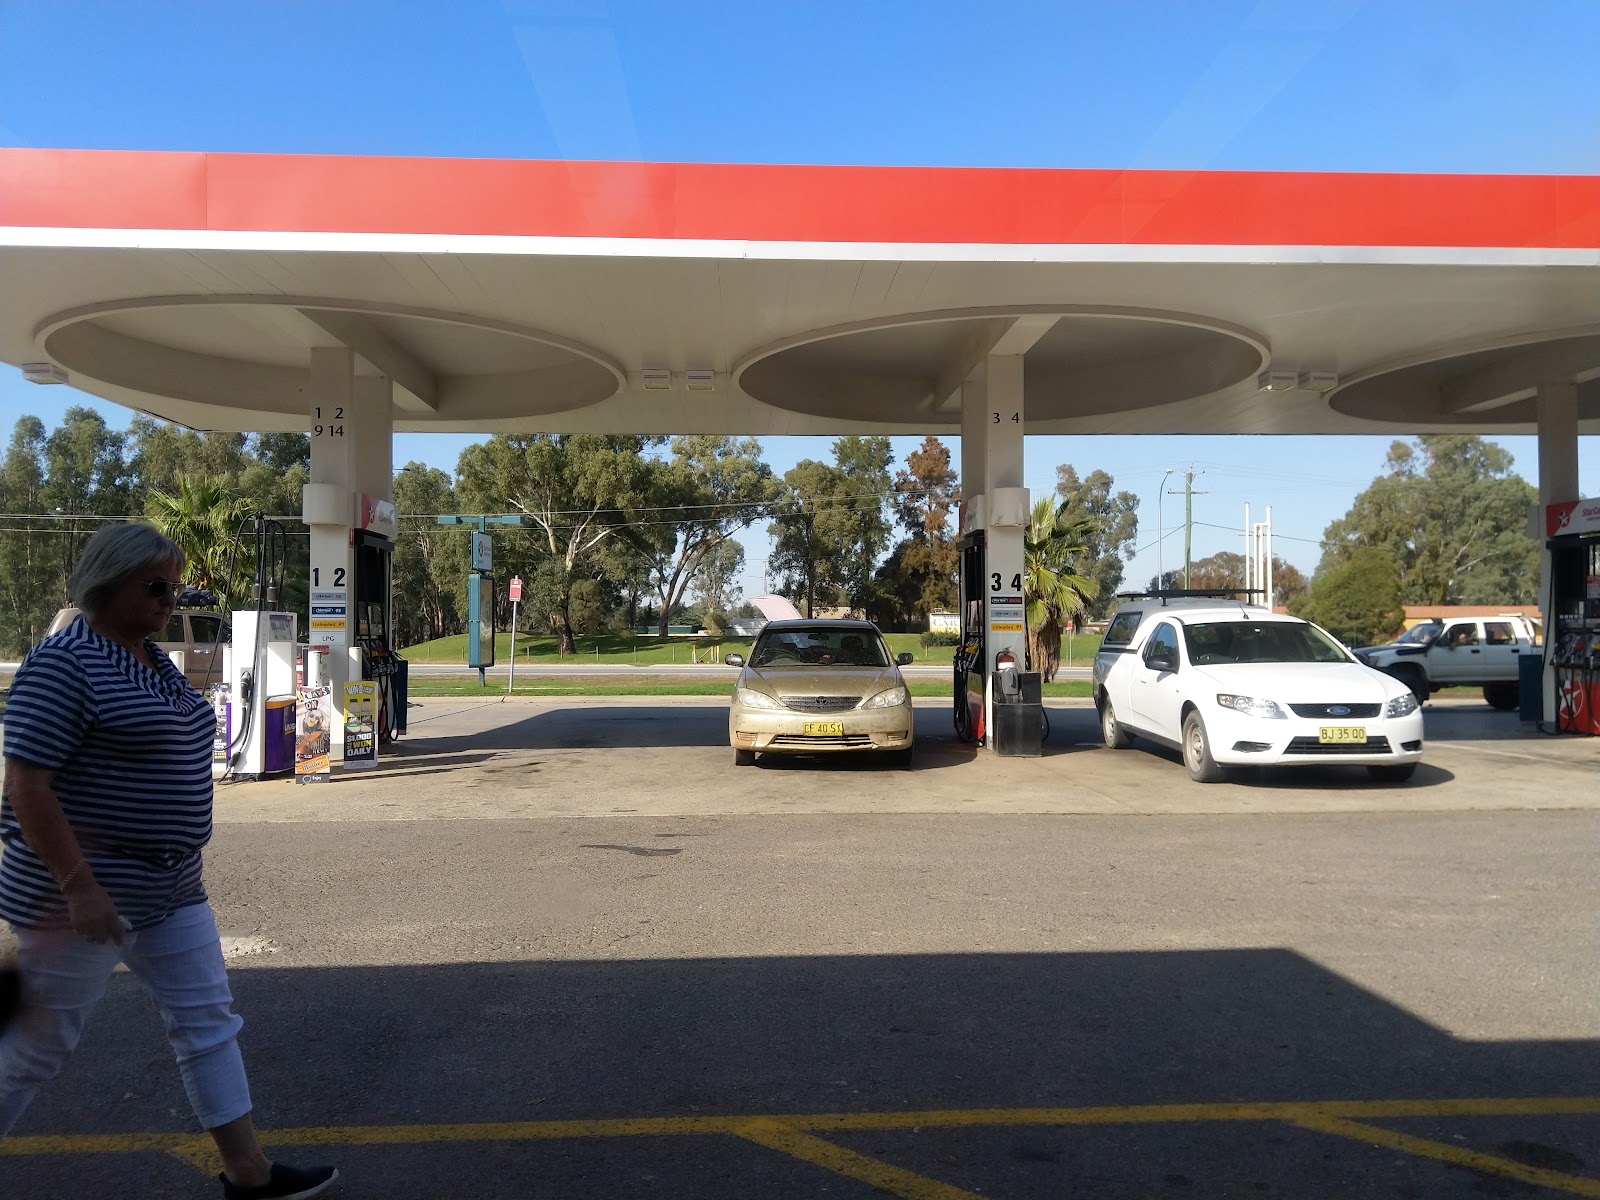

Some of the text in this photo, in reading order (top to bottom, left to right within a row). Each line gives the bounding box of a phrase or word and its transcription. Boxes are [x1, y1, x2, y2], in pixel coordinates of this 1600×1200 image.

[315, 407, 344, 419] 1 2
[993, 412, 1020, 424] 3 4
[314, 425, 345, 437] 9 14
[312, 567, 346, 588] 1 2
[991, 572, 1022, 591] 3 4
[1321, 728, 1334, 739] BJ
[1337, 728, 1349, 739] 35
[346, 747, 371, 757] DAILY
